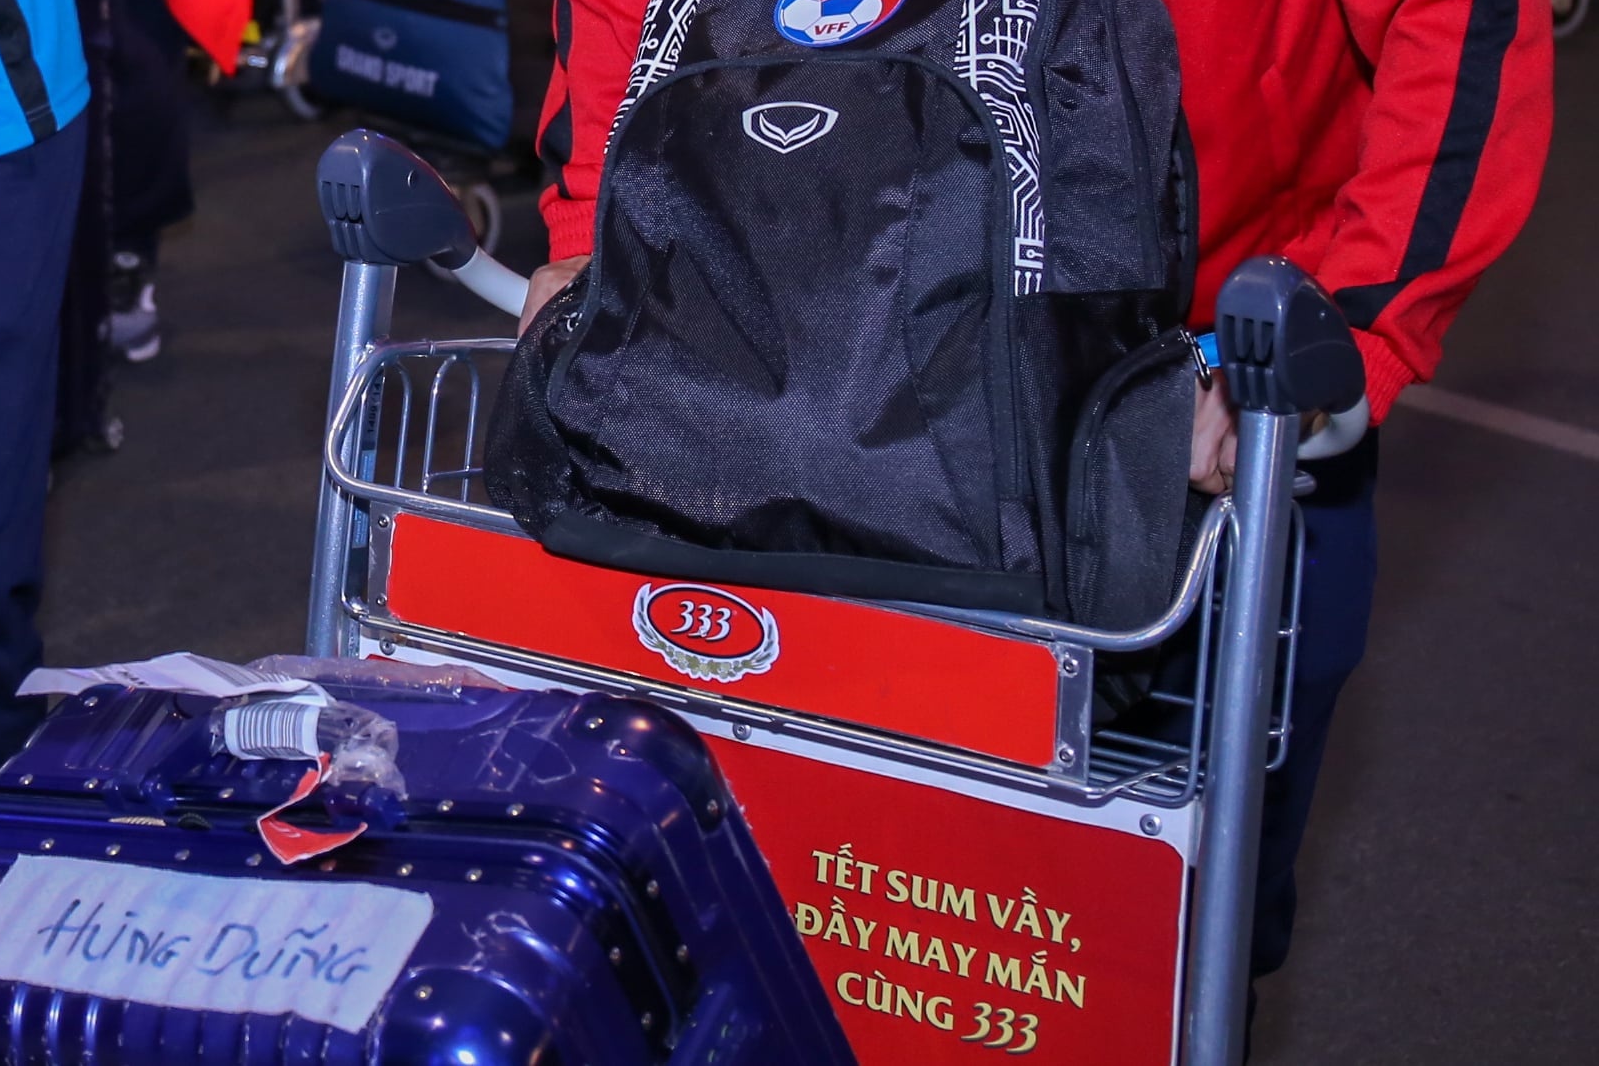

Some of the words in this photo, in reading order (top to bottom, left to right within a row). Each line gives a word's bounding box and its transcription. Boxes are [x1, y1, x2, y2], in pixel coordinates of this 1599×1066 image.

[814, 20, 850, 36] VFF
[670, 600, 732, 641] 333
[811, 843, 879, 895] TẾT
[885, 869, 977, 922] SUM
[986, 886, 1081, 953] VẦY,
[794, 895, 878, 952] ĐẦY
[884, 925, 977, 978] MAY
[984, 950, 1087, 1009] MẮN
[836, 970, 954, 1031] CÙNG
[960, 1002, 1039, 1055] 333
